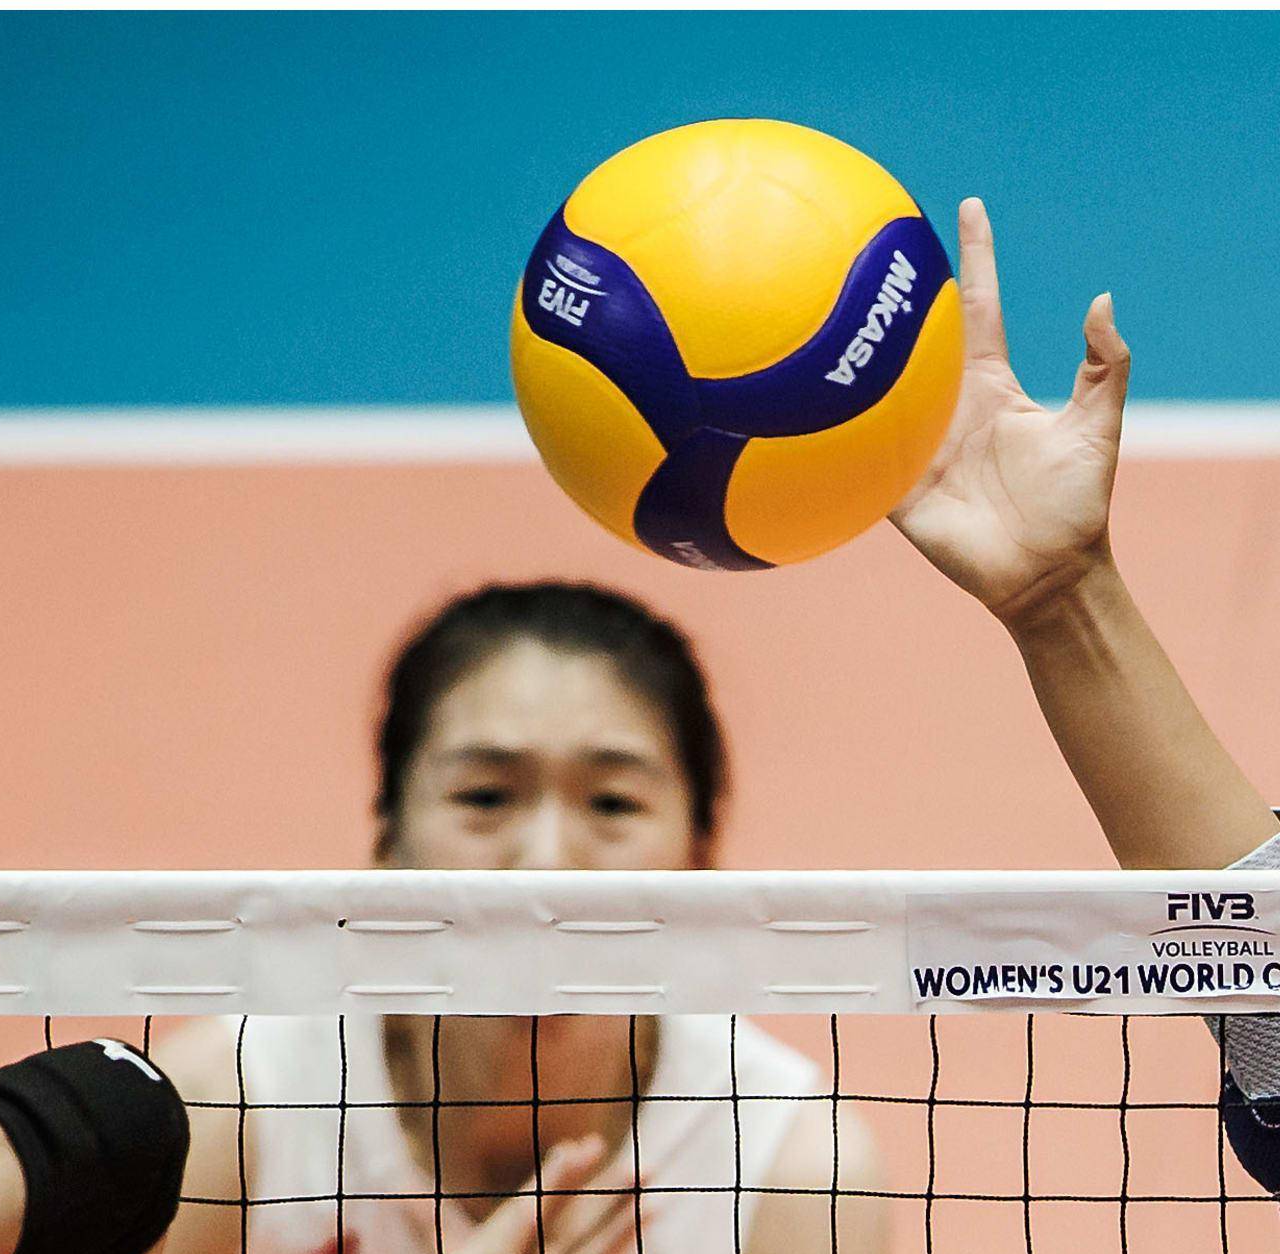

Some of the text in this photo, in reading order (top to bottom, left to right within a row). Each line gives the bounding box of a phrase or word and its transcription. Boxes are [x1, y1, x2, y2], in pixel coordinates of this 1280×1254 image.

[1167, 893, 1256, 920] FIVB
[1152, 941, 1274, 957] VOLLEYBALL
[914, 964, 1063, 997] WOMEN'S
[1072, 964, 1129, 994] U21
[1137, 963, 1254, 994] WORLD
